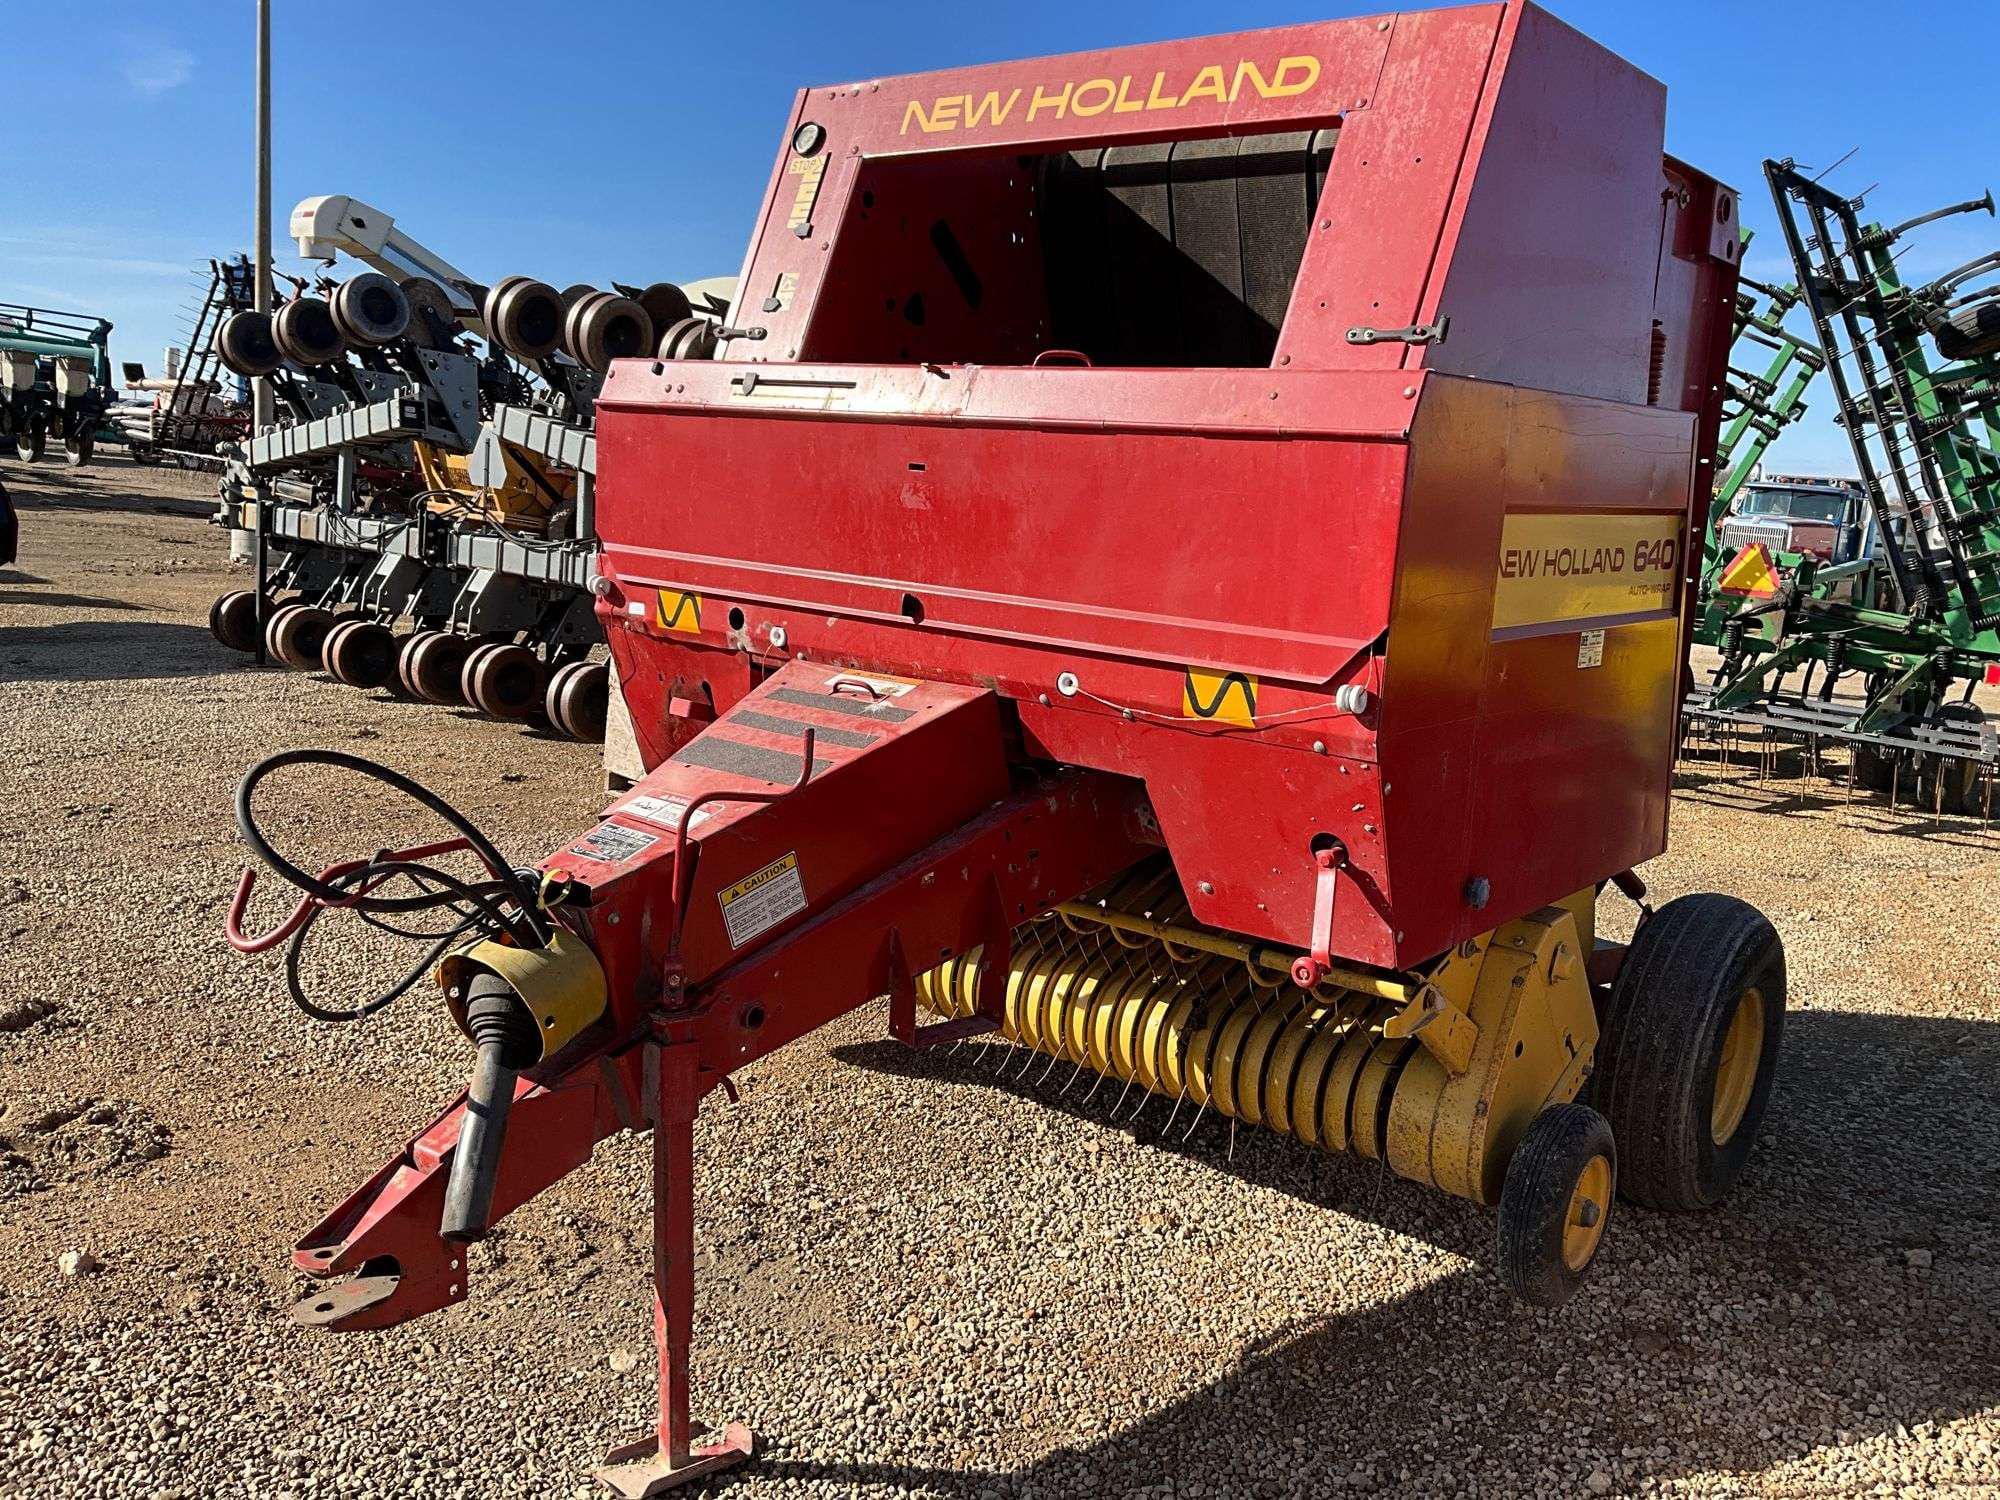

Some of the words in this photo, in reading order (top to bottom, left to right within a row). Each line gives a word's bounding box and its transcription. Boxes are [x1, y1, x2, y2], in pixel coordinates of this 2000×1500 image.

[900, 88, 1021, 135] NEW
[1026, 55, 1321, 122] HOLLAND
[1542, 547, 1625, 577] HOLLAND
[1633, 538, 1676, 573] 640
[743, 861, 787, 891] CAUTION
